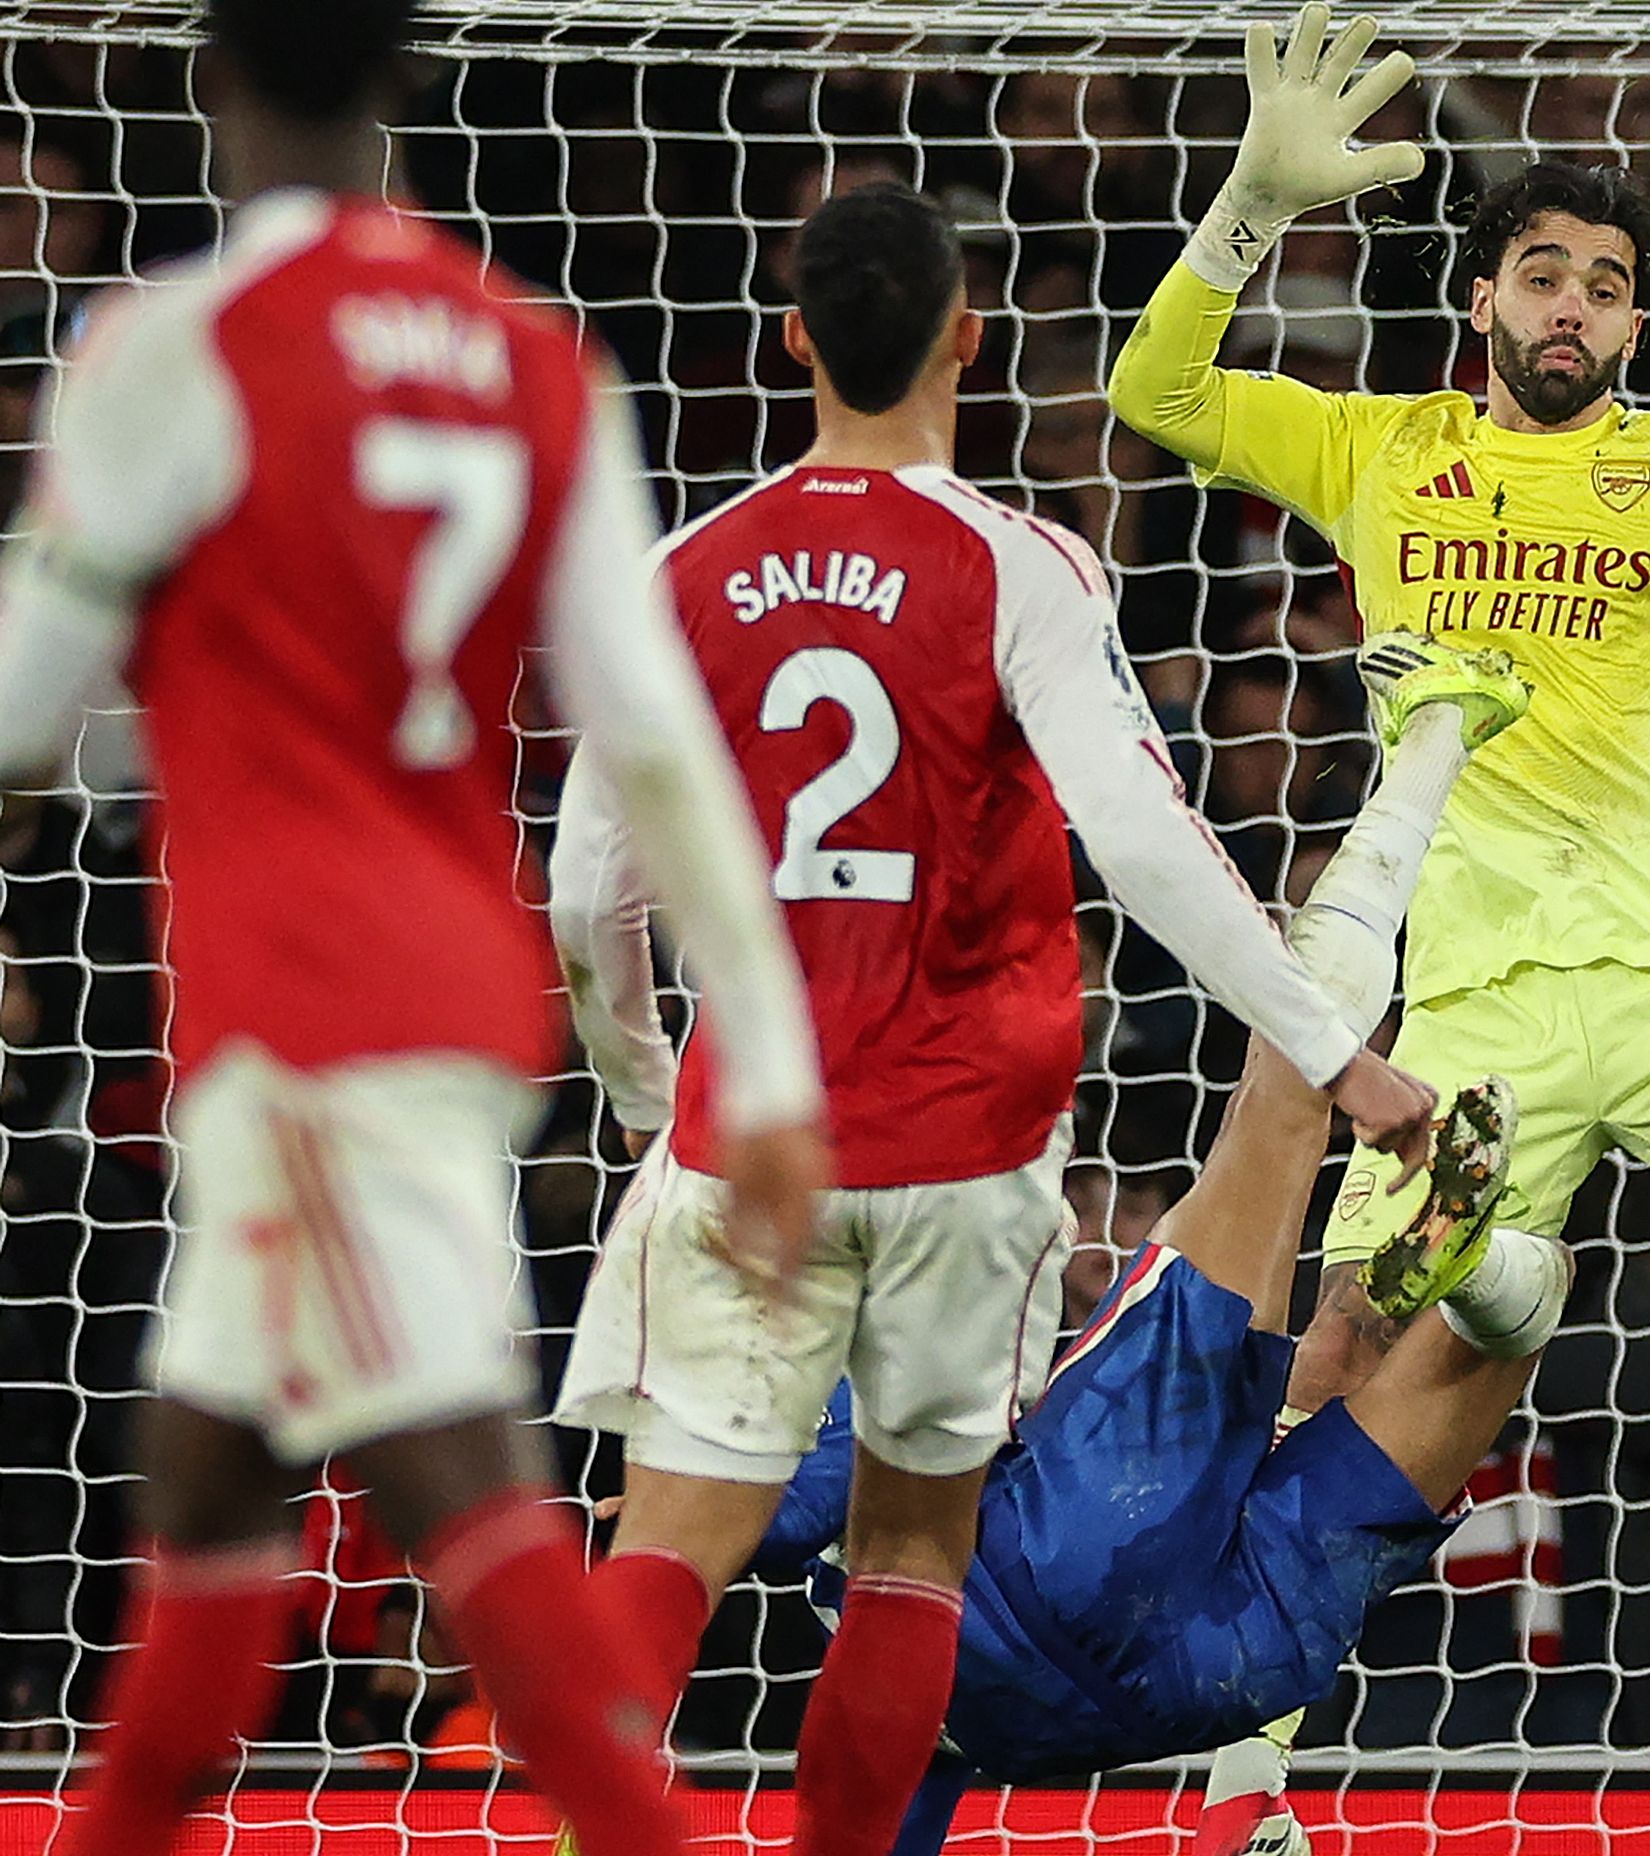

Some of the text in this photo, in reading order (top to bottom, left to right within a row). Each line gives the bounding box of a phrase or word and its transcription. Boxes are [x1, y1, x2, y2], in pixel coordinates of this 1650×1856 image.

[351, 414, 534, 770] 7
[725, 548, 907, 625] SALIBA
[1426, 590, 1609, 641] FLY BETTER
[758, 644, 917, 902] 2
